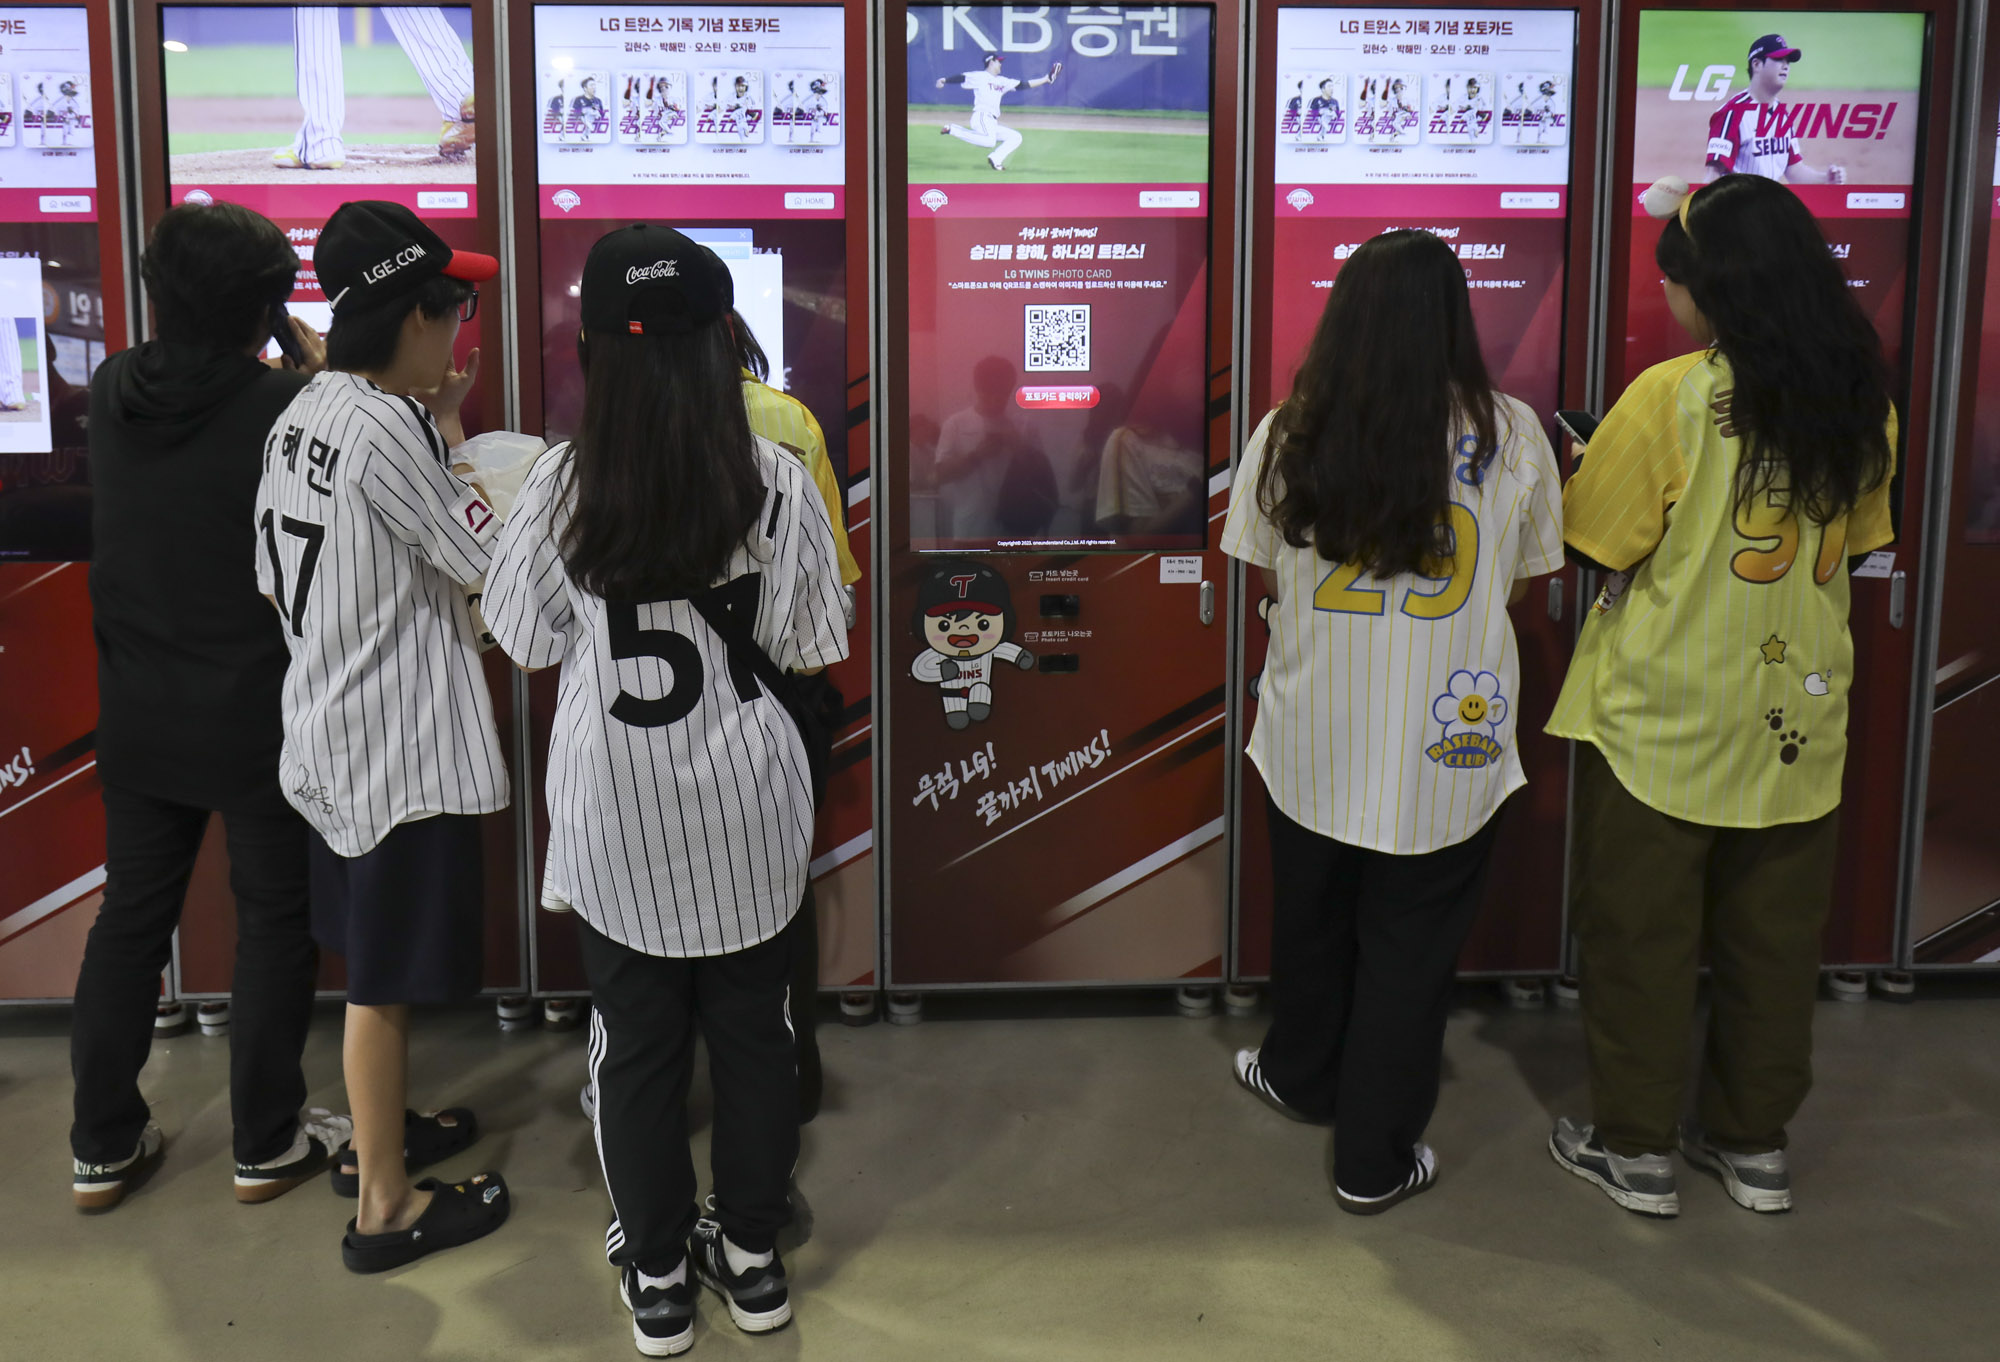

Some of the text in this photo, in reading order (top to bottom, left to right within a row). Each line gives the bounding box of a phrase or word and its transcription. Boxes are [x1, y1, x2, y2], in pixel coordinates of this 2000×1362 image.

[600, 17, 780, 33] LG 트윈스 기록 기념 포토카드
[1340, 20, 1513, 36] LG 트윈스 기록 기념 포토카드
[624, 42, 757, 53] 김현수 박해민 오스틴 오지환
[1362, 44, 1490, 56] 김현수 박해민 오스틴 오지환
[1668, 64, 1736, 101] LG
[1729, 102, 1898, 140] TWINS!
[805, 197, 825, 205] HOME
[970, 243, 1147, 261] 승리를 향해, 하나의 트윈스!
[1457, 243, 1506, 260] 트윈스!
[362, 243, 428, 285] LGE.COM
[626, 259, 678, 285] Coca-Cola
[1004, 269, 1113, 279] LG TWINS PHOTO CARD
[1024, 391, 1057, 402] 포토카드
[265, 424, 341, 498] 해민
[260, 507, 326, 638] 17
[1426, 733, 1502, 764] BASEBALL
[1444, 753, 1487, 767] CLUB
[912, 741, 997, 812] 무적 LG!
[976, 728, 1112, 827] 끝까지 TWINS!
